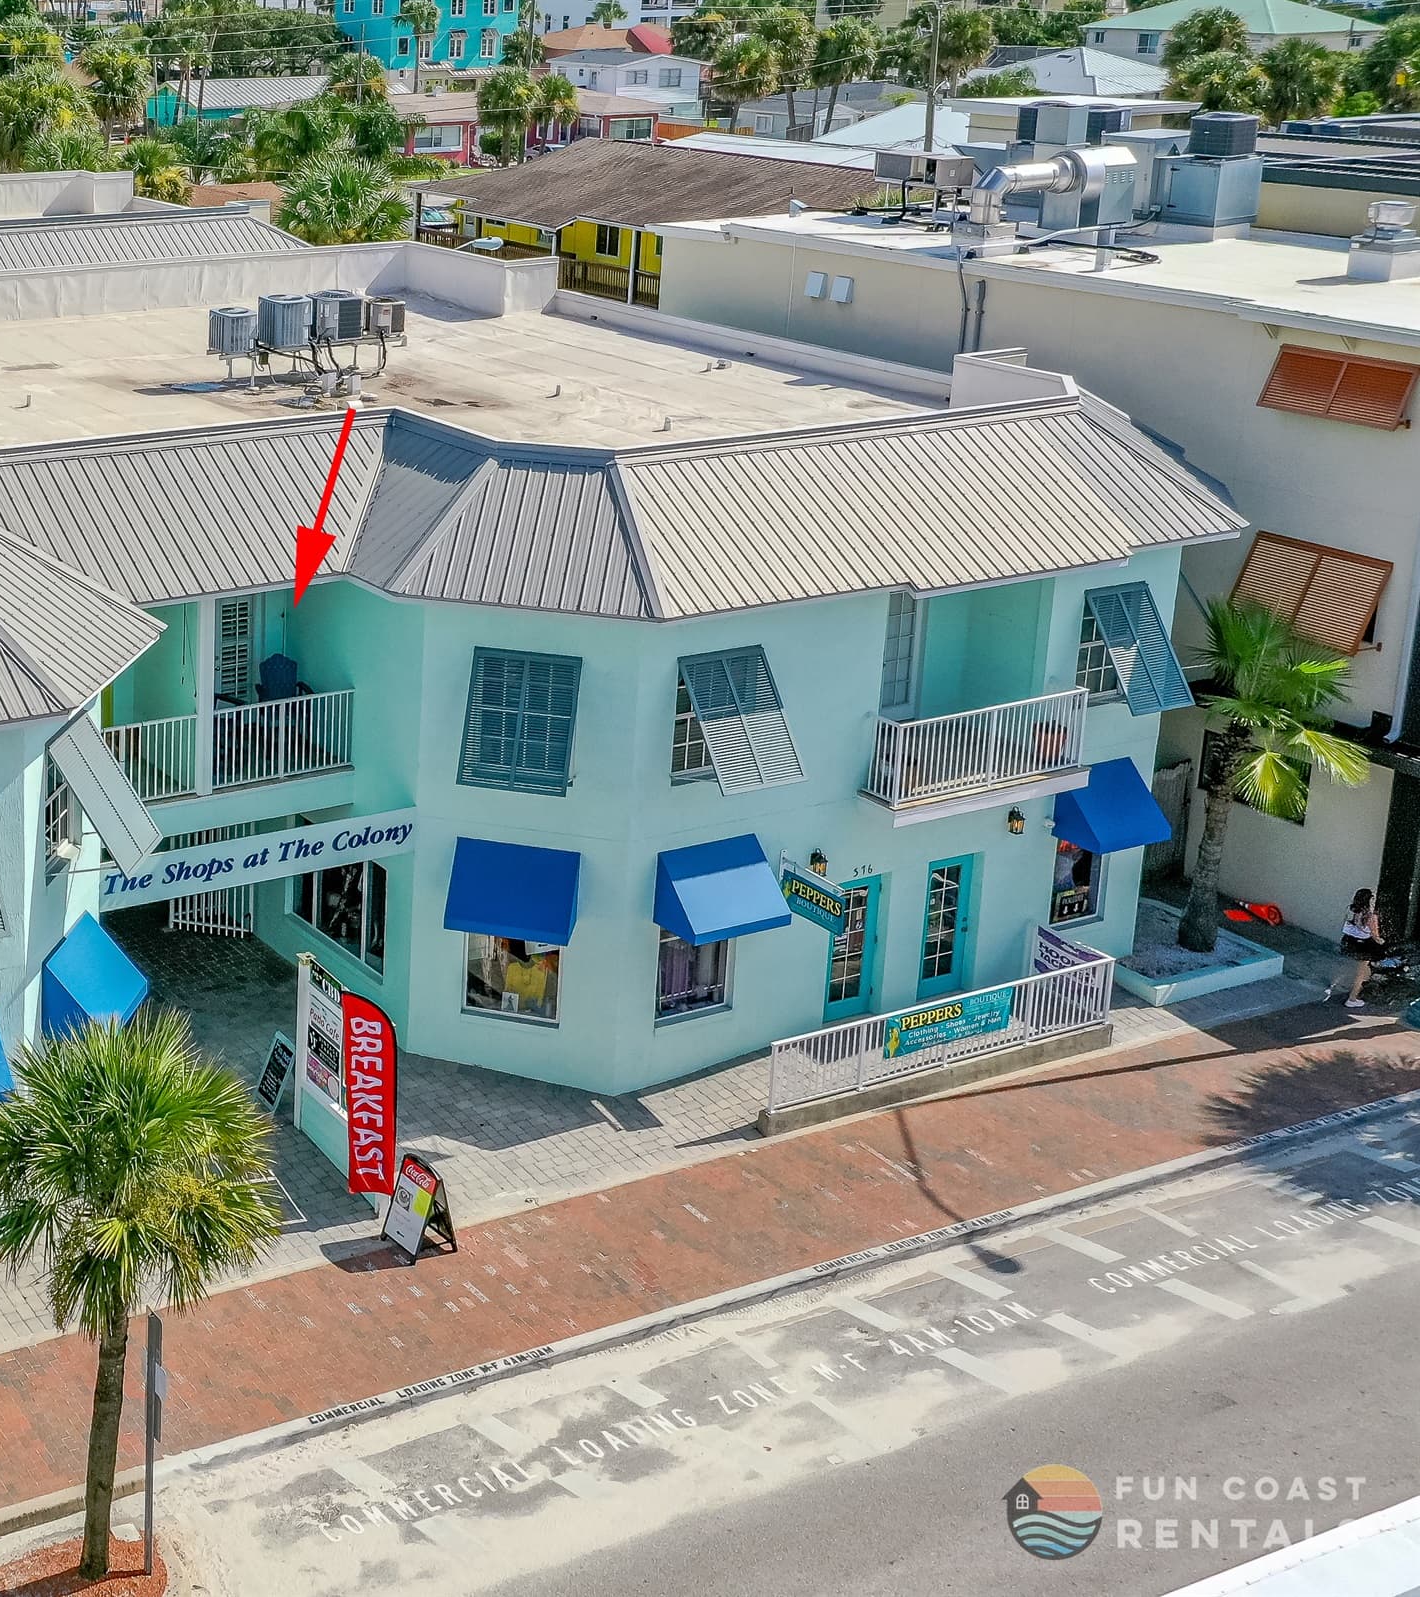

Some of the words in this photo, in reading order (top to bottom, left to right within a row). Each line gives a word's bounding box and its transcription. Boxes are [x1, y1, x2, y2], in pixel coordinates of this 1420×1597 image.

[162, 856, 233, 886] Shops
[243, 851, 269, 869] at
[279, 839, 324, 862] The
[331, 822, 413, 850] Colony
[791, 879, 842, 916] PEPPERS
[908, 1026, 939, 1039] Clothing
[946, 1019, 966, 1029] Shoes
[350, 1017, 384, 1182] BREAKFAST
[813, 1250, 878, 1273] COMMERCIAL
[882, 1236, 926, 1253] LOADING
[926, 1230, 954, 1241] ZONE
[1088, 1234, 1259, 1295] COMMERCIAL
[1254, 1198, 1372, 1241] LOADING
[1364, 1177, 1420, 1206] ZON
[308, 1397, 386, 1426] COMMERCIAL
[396, 1378, 447, 1399] LOADING
[447, 1368, 478, 1384] ZONE
[479, 1361, 499, 1375] M-F
[503, 1346, 555, 1366] 4AM-10AM
[319, 1461, 539, 1543] COMMERCIAL
[552, 1407, 698, 1467] LOADING
[708, 1376, 797, 1416] ZONE
[811, 1352, 867, 1383] M-F
[888, 1301, 1037, 1357] 4AM-10AM
